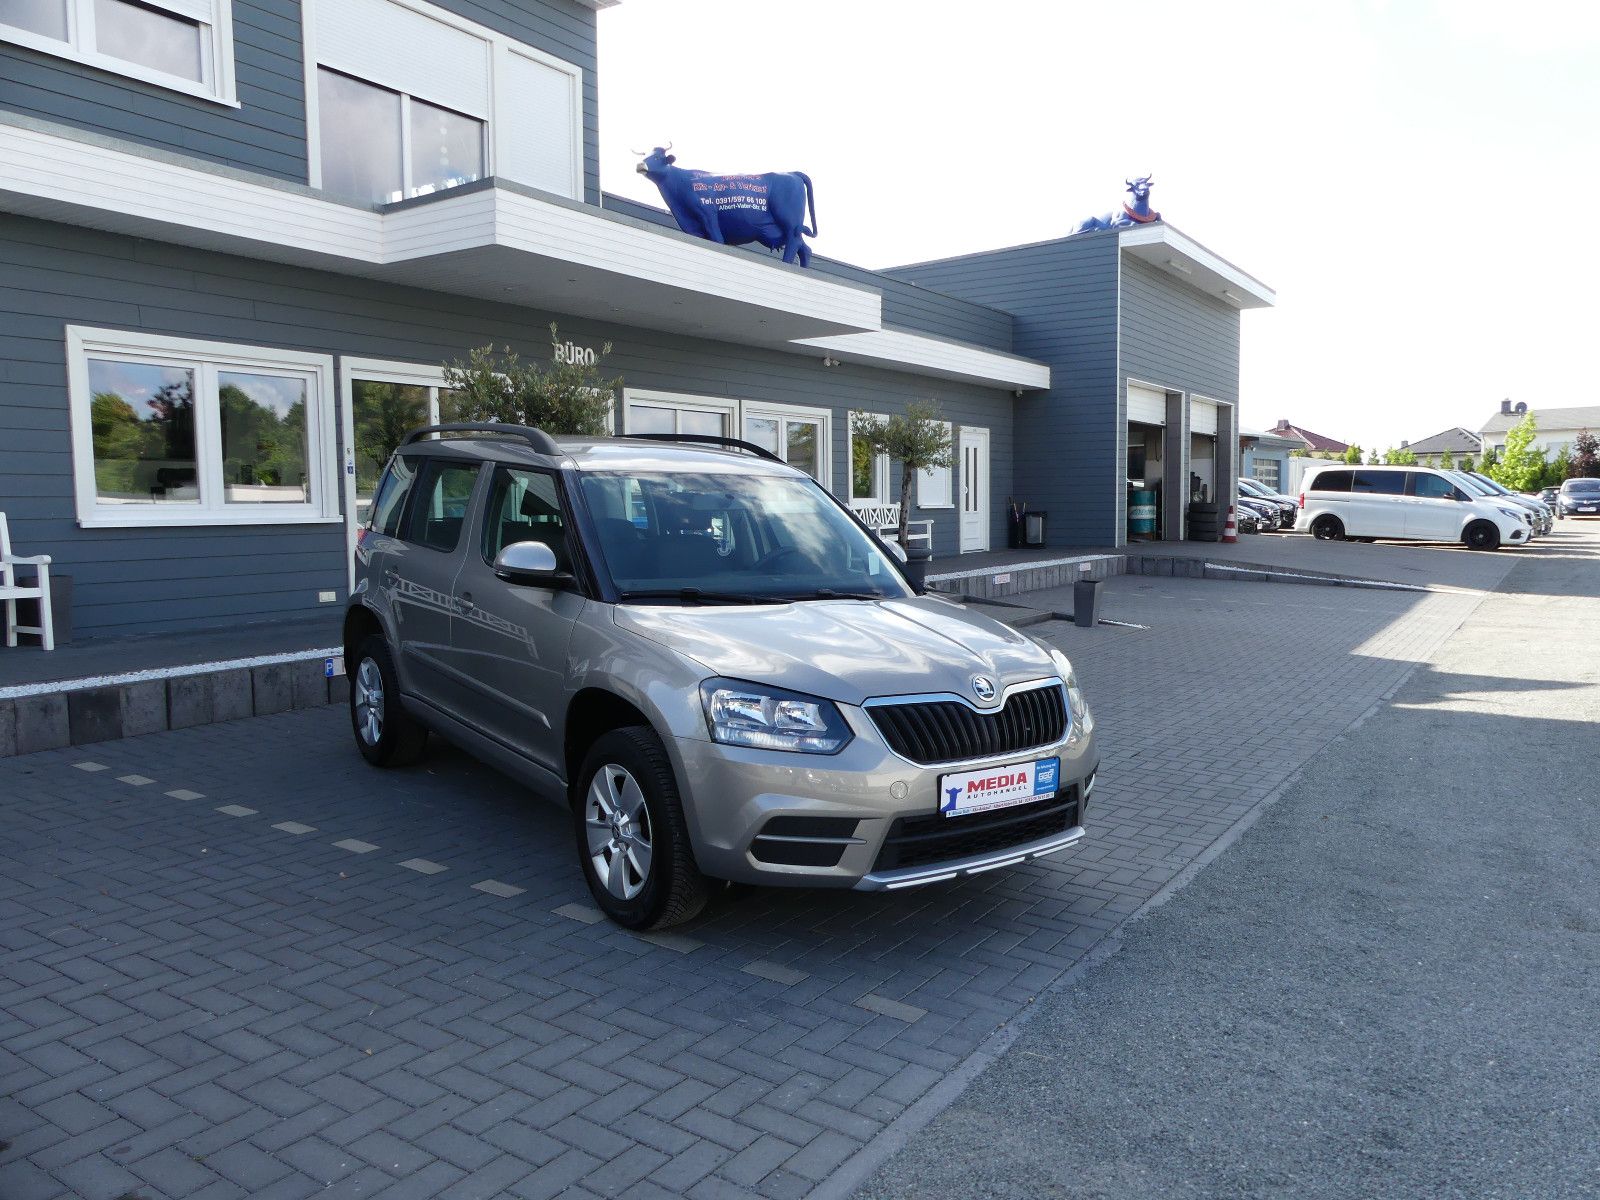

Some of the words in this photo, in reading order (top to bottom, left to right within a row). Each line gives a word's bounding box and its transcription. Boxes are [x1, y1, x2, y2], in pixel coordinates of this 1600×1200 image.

[715, 196, 745, 205] 0391/597
[554, 341, 595, 366] BÜRO
[967, 772, 1028, 793] MEDIA
[966, 785, 1028, 800] AUTOHANDEL
